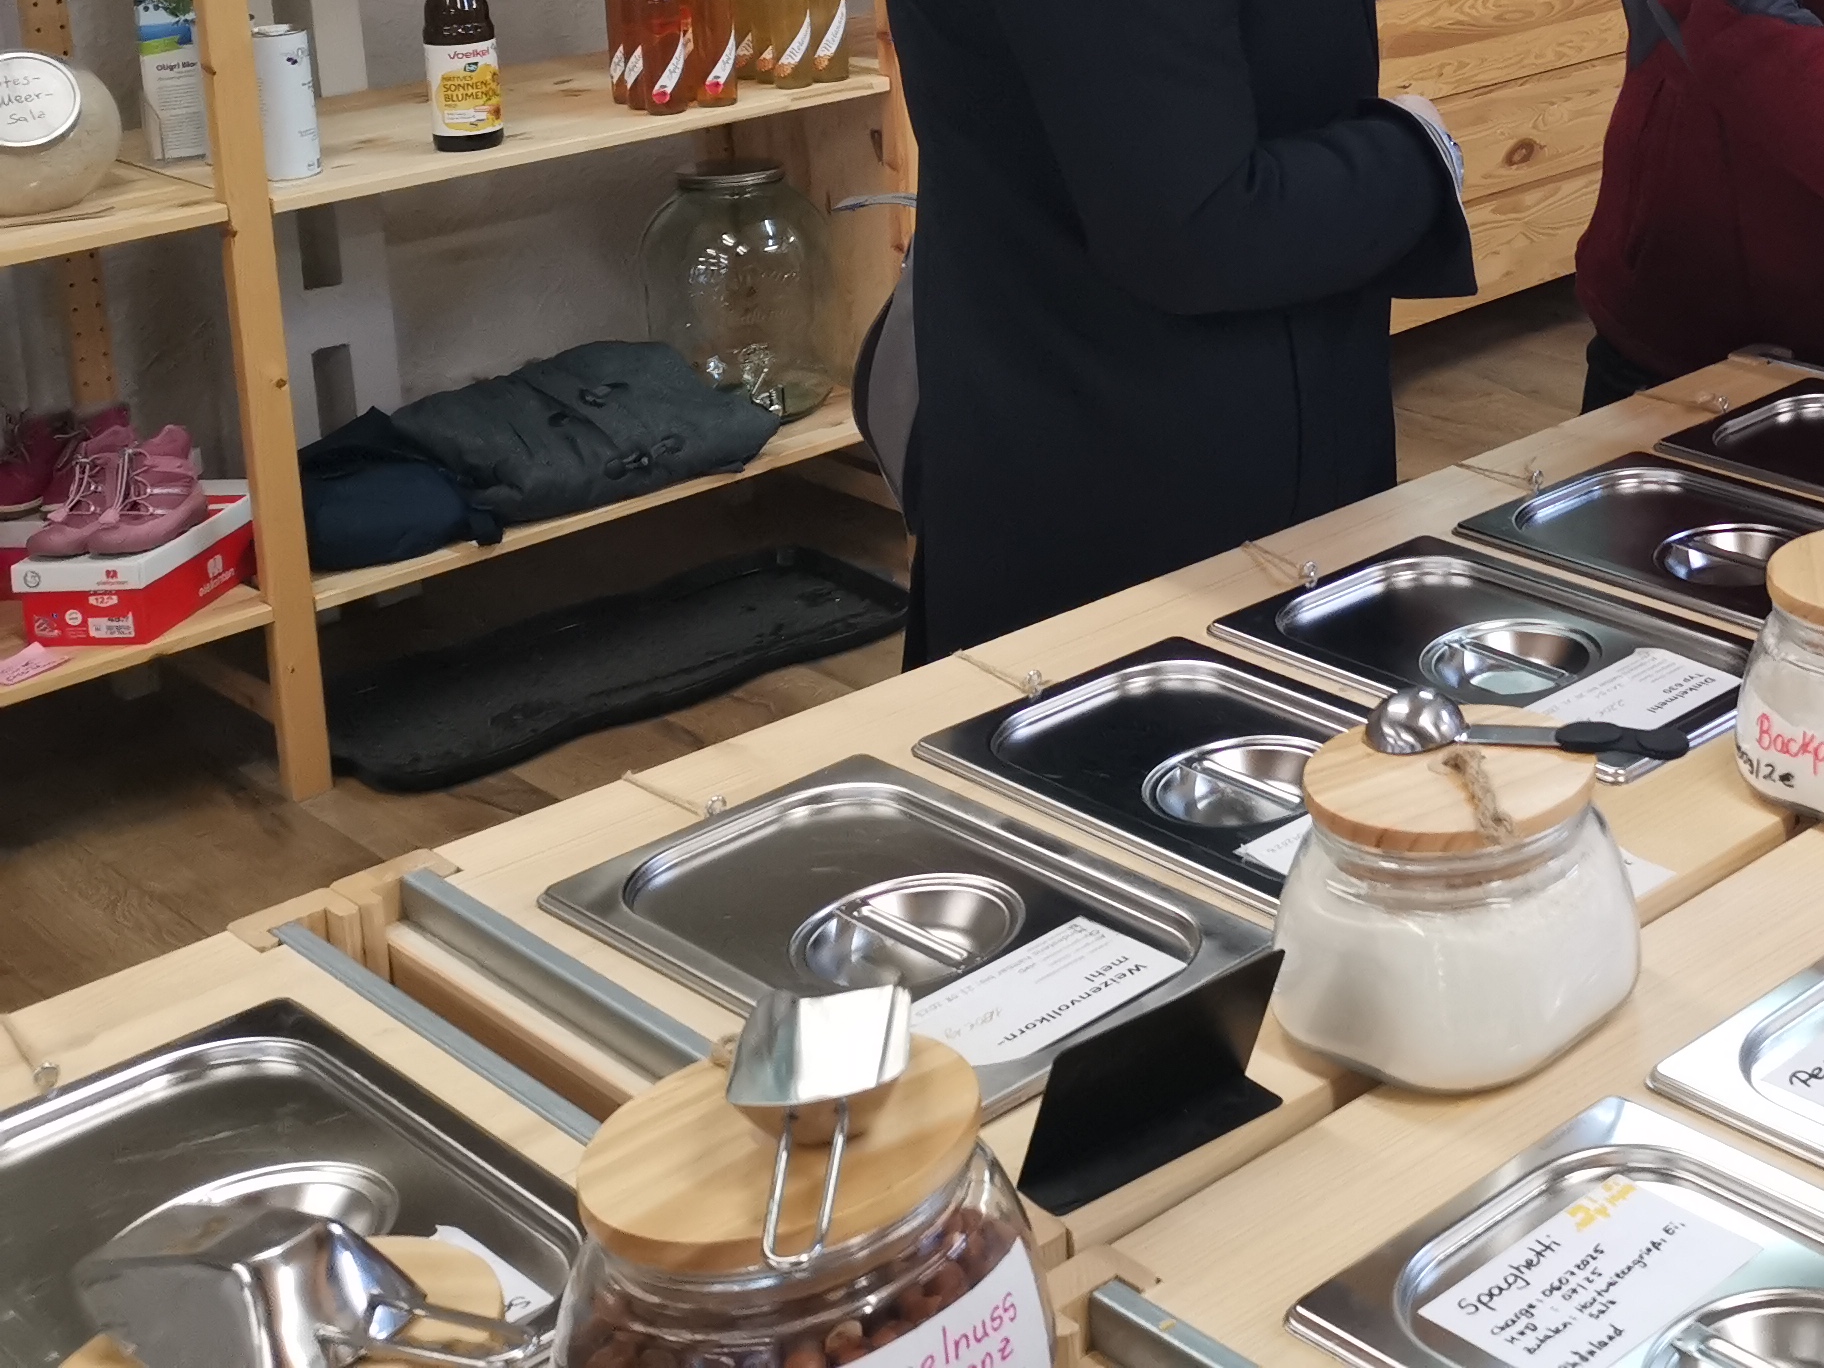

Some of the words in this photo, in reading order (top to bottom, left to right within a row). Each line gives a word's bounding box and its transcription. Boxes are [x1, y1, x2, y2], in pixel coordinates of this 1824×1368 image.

[448, 47, 490, 60] Voelkel
[0, 75, 41, 88] tes-
[443, 80, 492, 93] SONNEN-
[1646, 676, 1717, 715] Dinkelmehl
[1083, 954, 1130, 984] mehl
[996, 962, 1148, 1047] Weizenvollkorn-
[1457, 1234, 1562, 1316] Spaghetti
[908, 1291, 1018, 1368] elnuss
